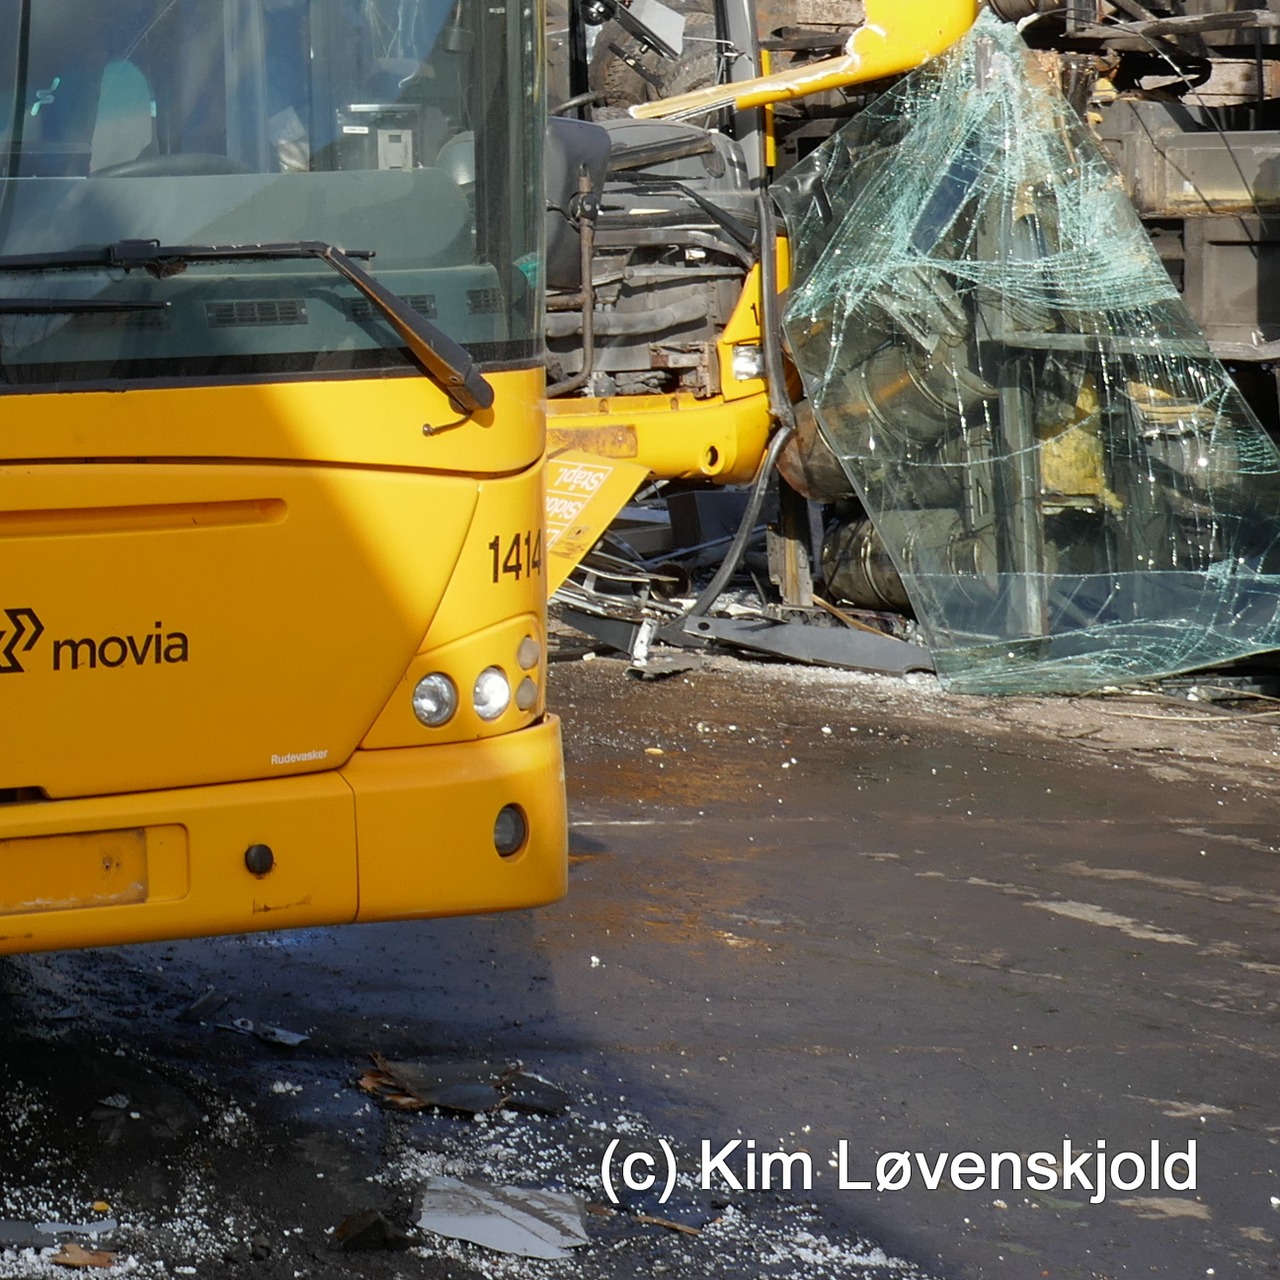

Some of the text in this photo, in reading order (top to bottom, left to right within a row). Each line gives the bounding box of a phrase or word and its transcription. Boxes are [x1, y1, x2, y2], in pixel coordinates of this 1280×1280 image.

[488, 528, 542, 584] 1414
[52, 621, 189, 671] movia
[270, 748, 329, 766] Rudevasker
